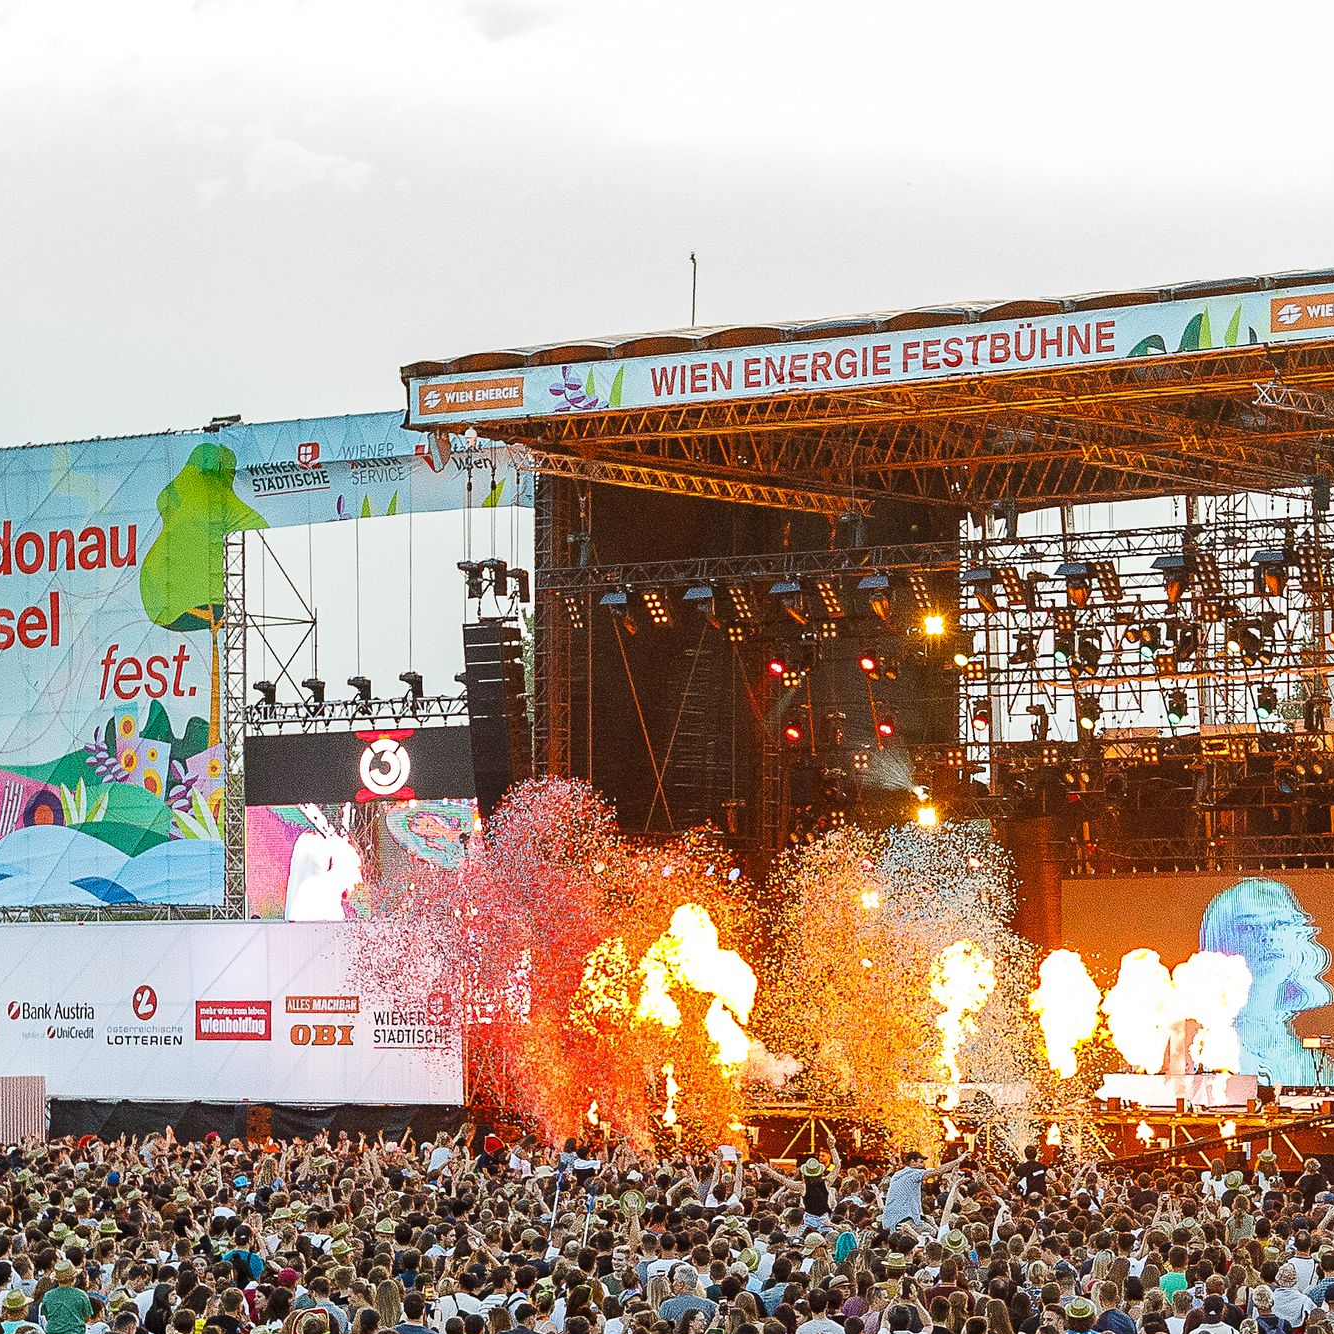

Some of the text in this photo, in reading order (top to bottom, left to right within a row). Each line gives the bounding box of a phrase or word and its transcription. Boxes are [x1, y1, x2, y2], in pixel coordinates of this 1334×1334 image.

[651, 320, 1116, 398] WIEN ENERGIE FESTBÜHNE
[444, 386, 520, 405] WIEN ENERGIE
[342, 442, 395, 458] WIENER
[252, 470, 330, 492] STÄDTISCHE
[352, 467, 406, 485] SERVICE
[99, 643, 198, 700] fest.
[22, 1002, 94, 1020] Bank Austria
[287, 999, 357, 1011] ALLES MACHBAR
[374, 1011, 426, 1026] WIENER
[57, 1027, 94, 1039] UniCredit
[107, 1035, 183, 1046] LOTTERIEN
[290, 1024, 354, 1045] OBI
